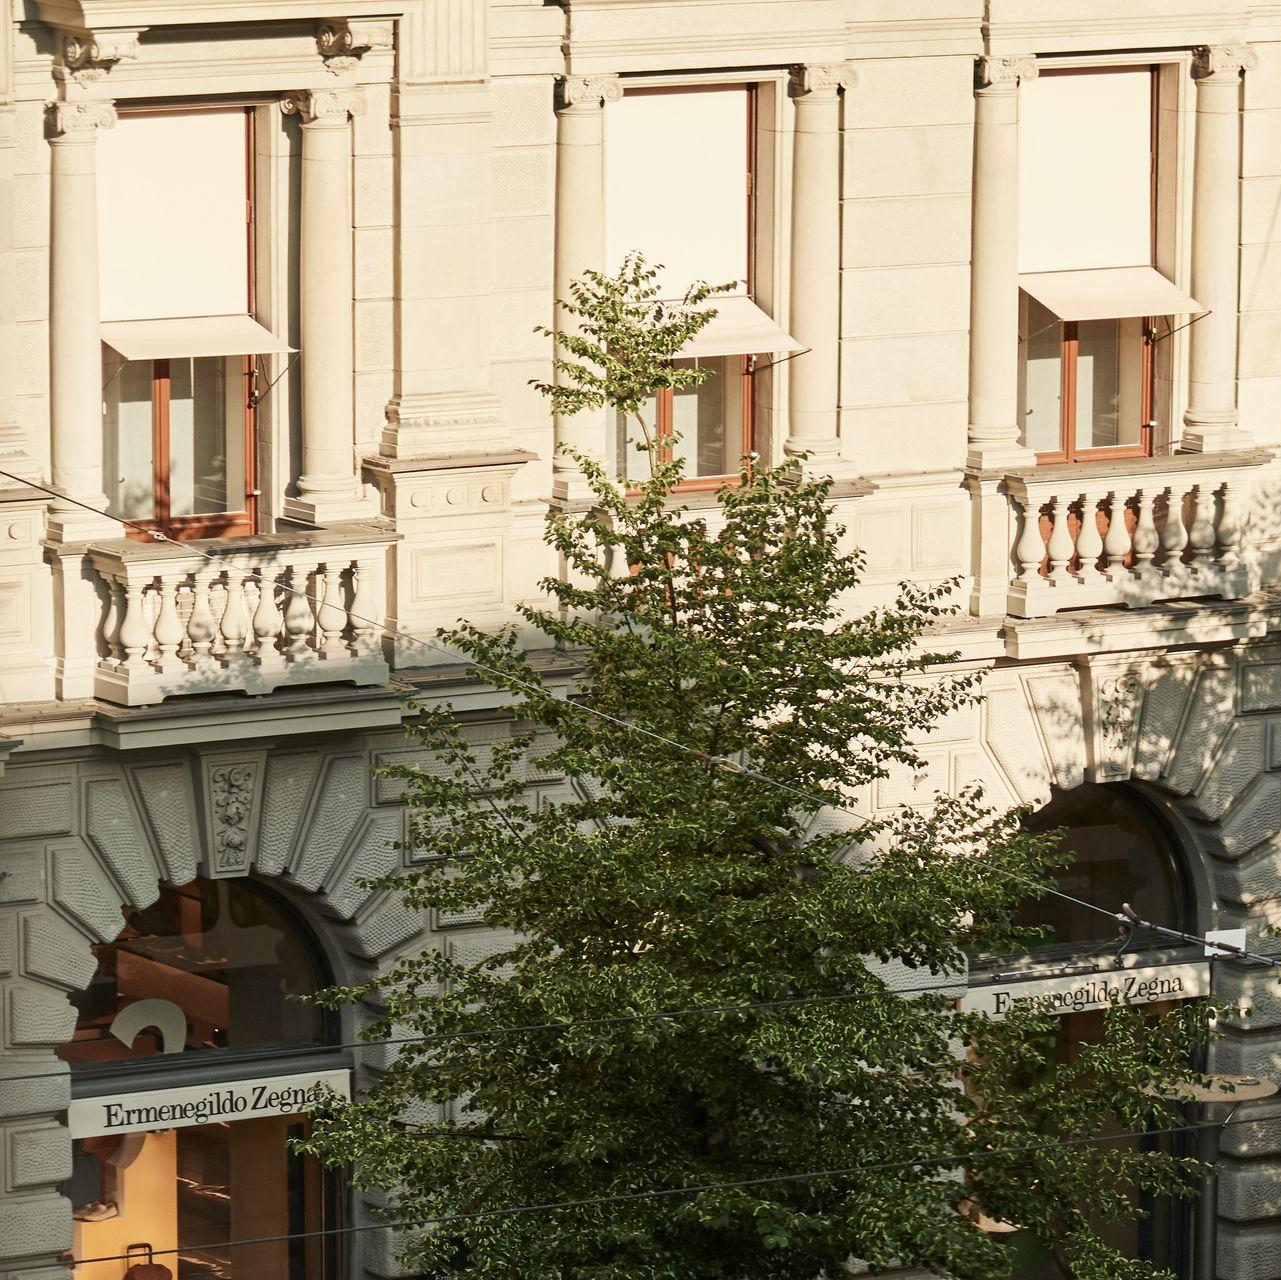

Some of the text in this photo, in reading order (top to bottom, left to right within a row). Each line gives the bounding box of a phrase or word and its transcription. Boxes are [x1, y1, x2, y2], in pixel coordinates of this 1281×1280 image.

[1124, 976, 1183, 999] Zegna
[103, 1085, 321, 1128] Ermenegildo Zegna
